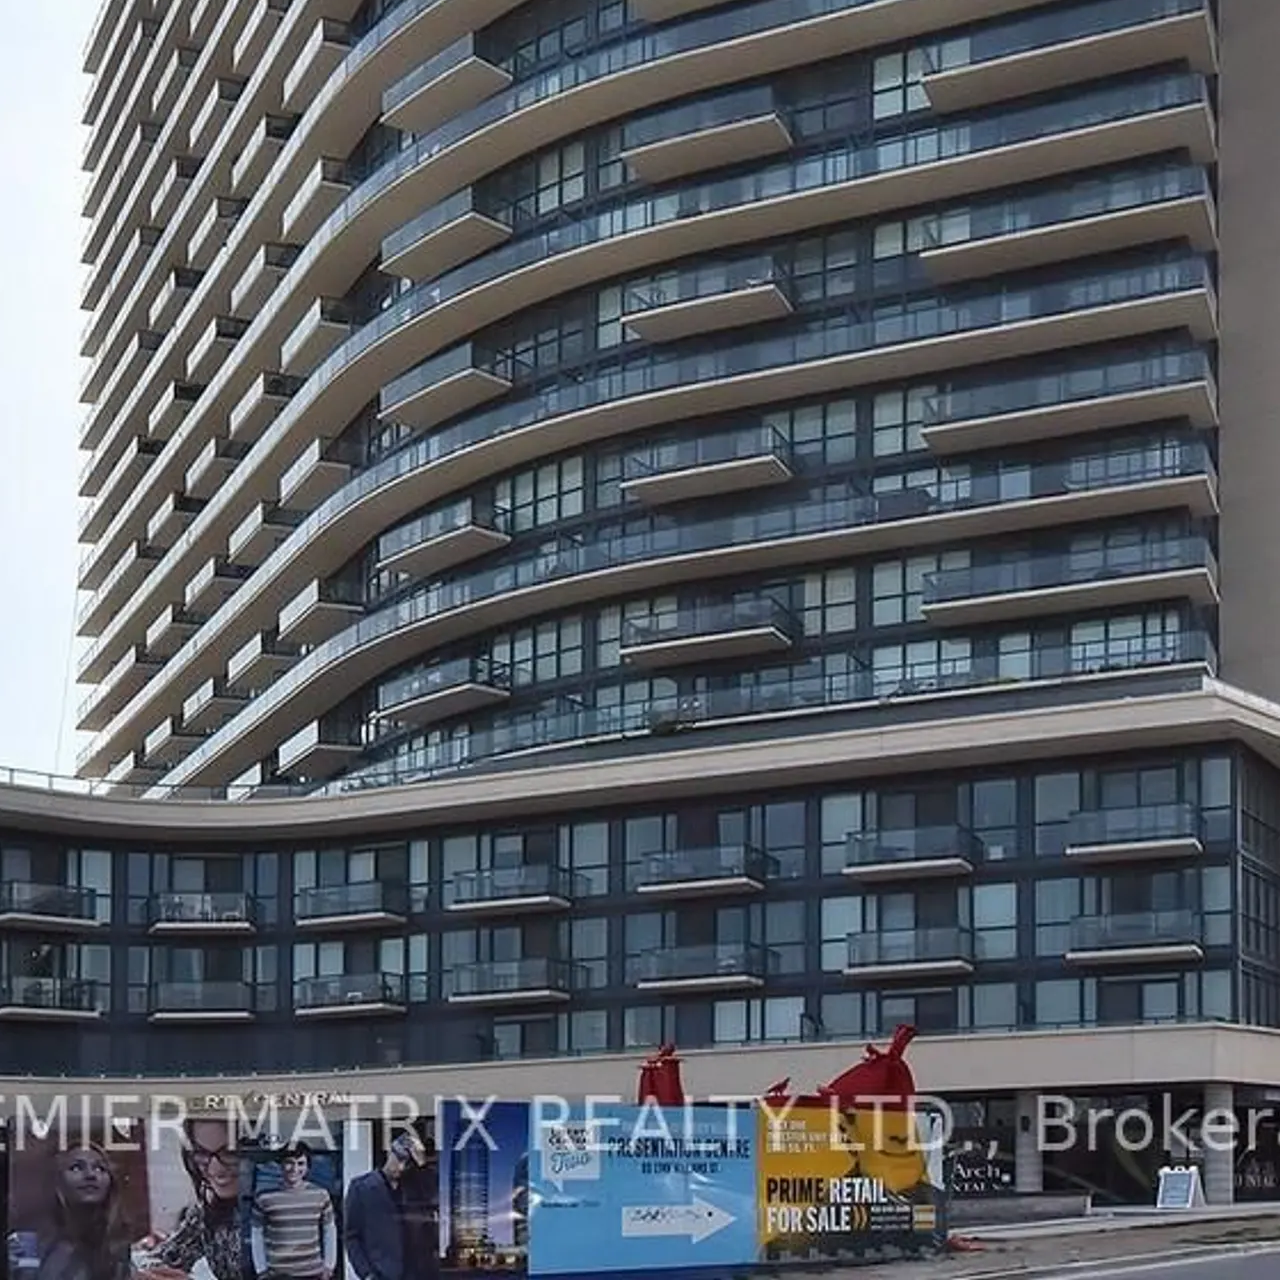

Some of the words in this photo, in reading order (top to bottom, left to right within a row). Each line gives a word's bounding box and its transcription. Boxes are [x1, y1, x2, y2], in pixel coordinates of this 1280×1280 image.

[767, 1177, 824, 1205] PRIME
[829, 1176, 888, 1204] RETAIL
[767, 1206, 802, 1234] FOR
[806, 1205, 851, 1232] SALE
